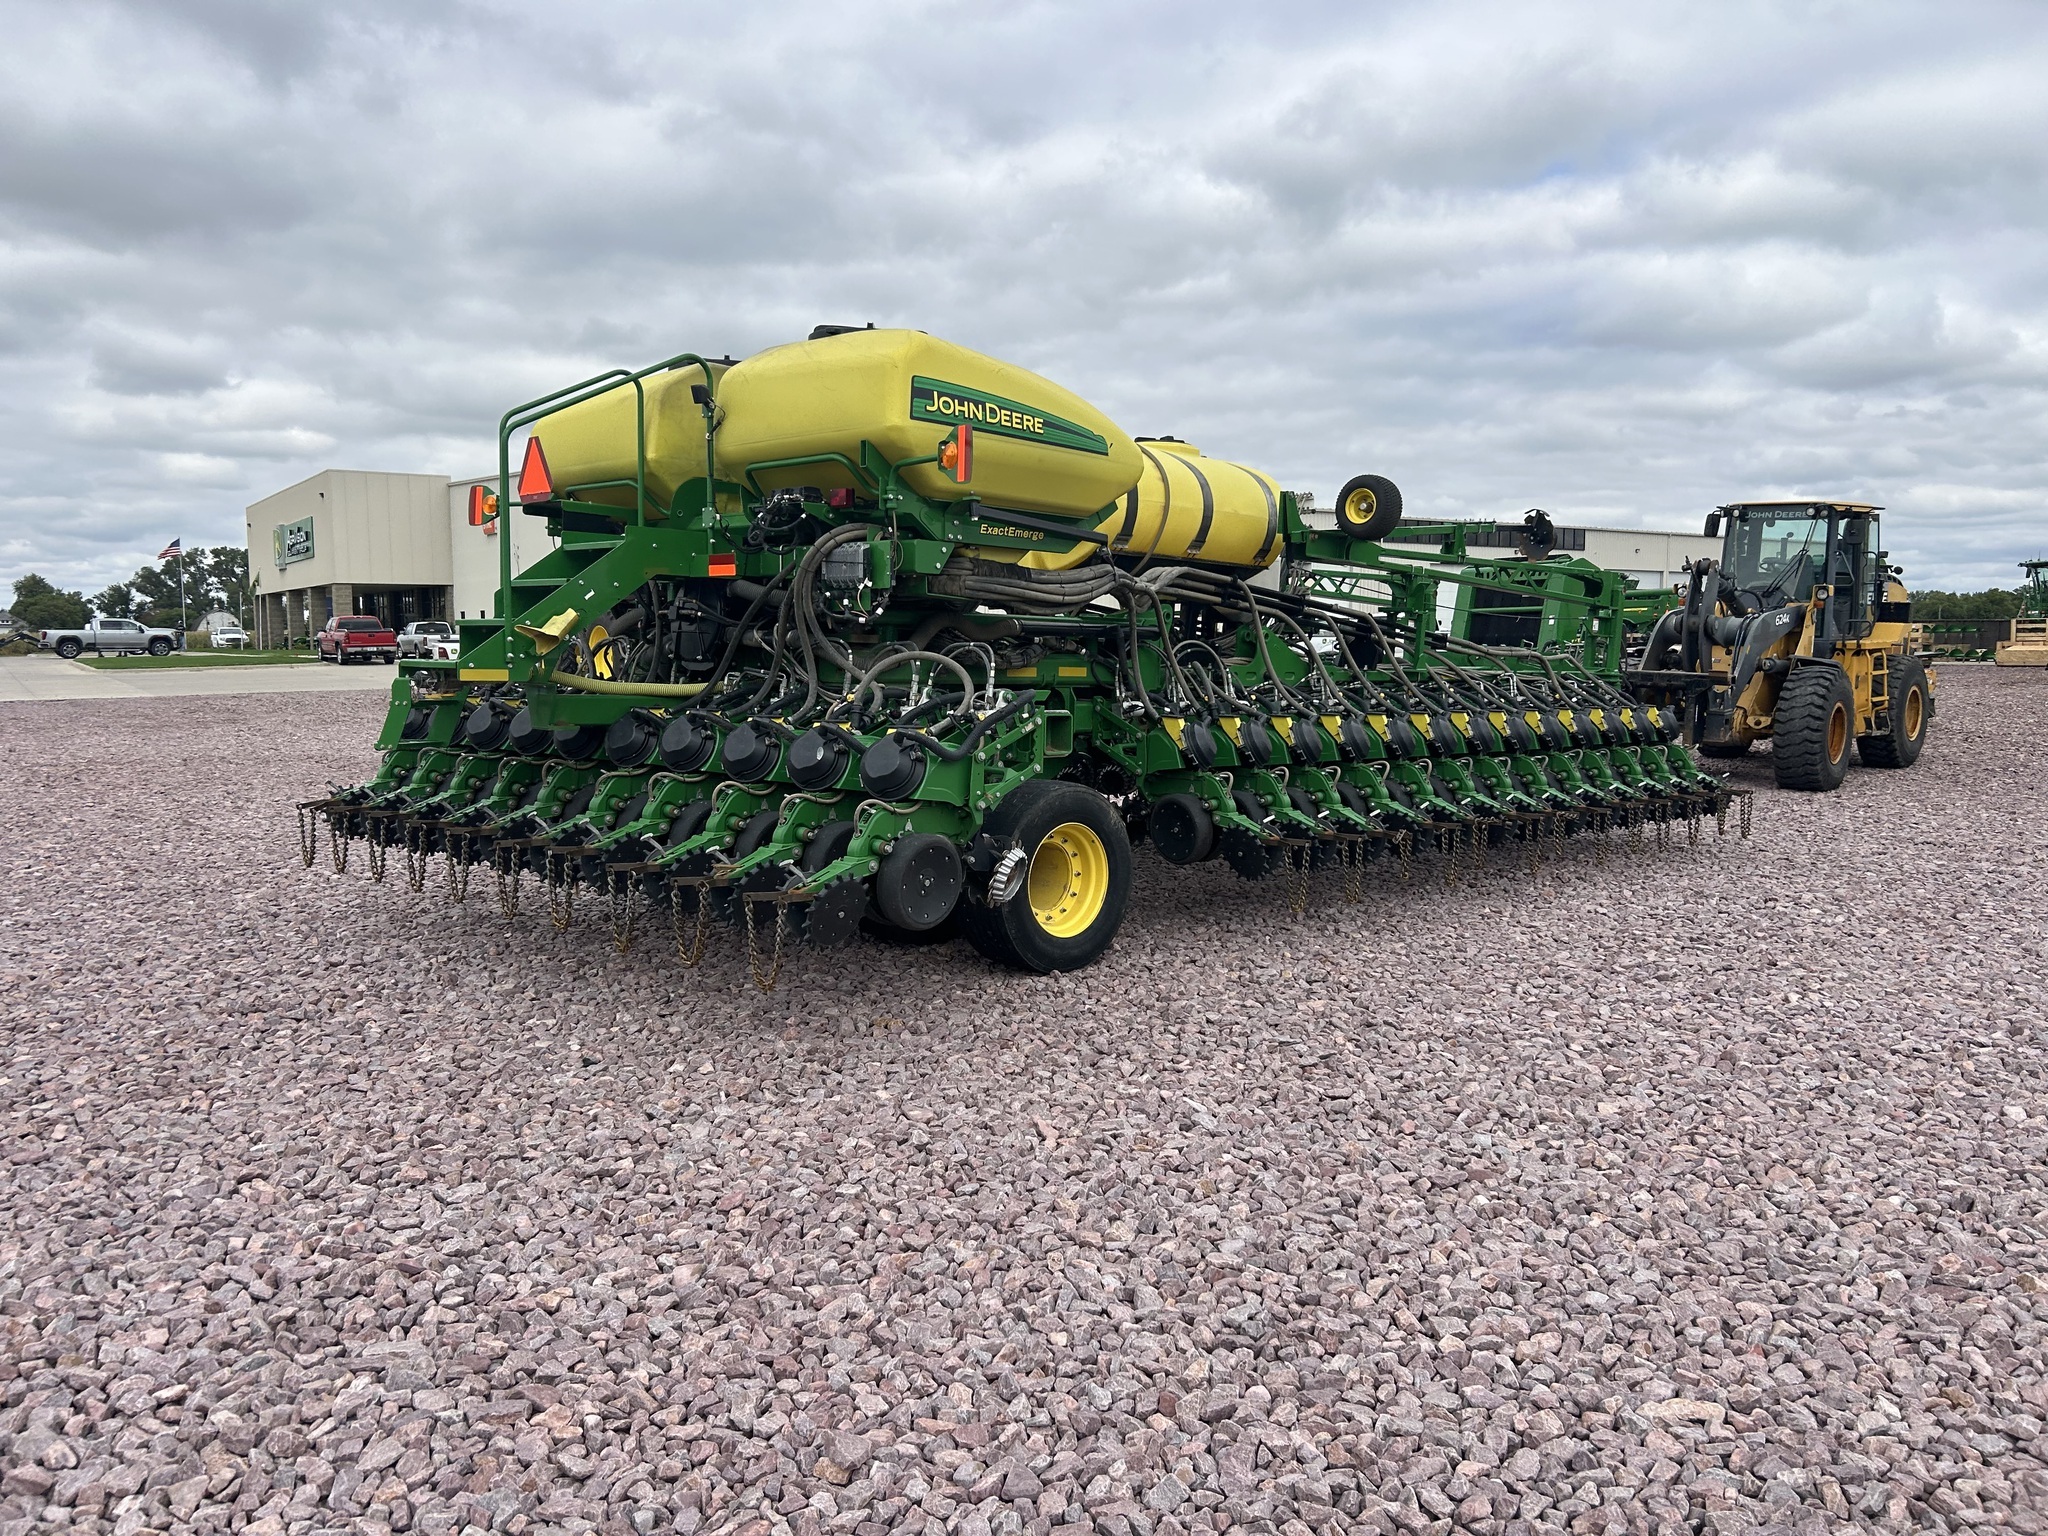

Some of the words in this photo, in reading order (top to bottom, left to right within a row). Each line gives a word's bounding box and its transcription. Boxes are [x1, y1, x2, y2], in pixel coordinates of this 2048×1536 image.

[926, 391, 982, 420] JOHN
[985, 402, 1044, 434] DEERE
[980, 524, 1044, 540] ExactEmerge
